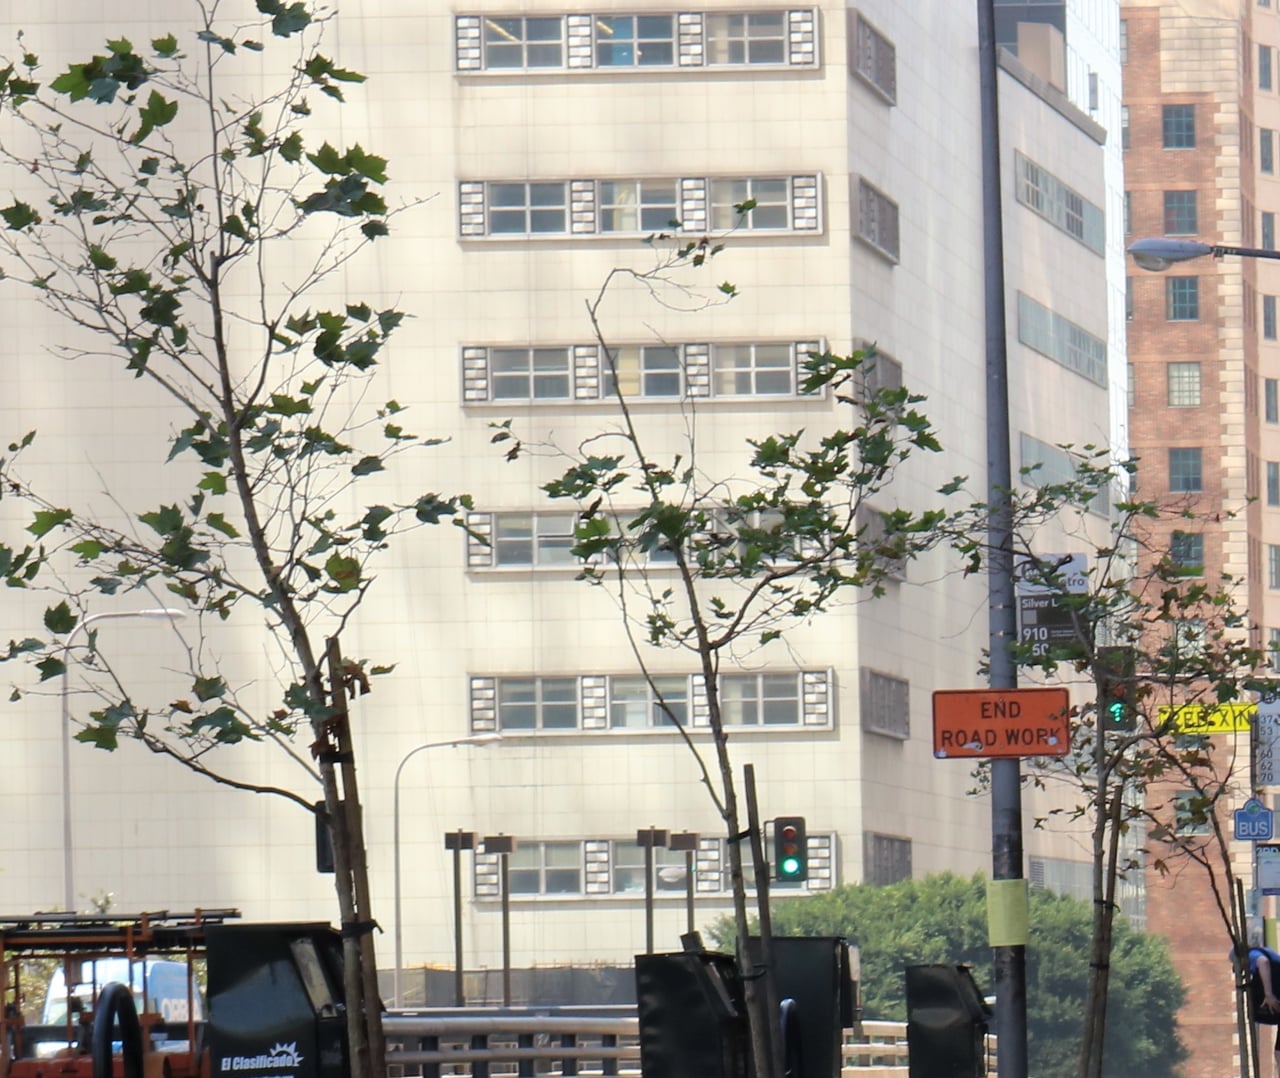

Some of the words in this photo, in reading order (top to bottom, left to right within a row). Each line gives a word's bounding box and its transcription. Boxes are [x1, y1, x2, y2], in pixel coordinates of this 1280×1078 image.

[1022, 598, 1049, 609] Silver
[1023, 627, 1048, 641] 910
[981, 701, 1021, 719] END
[1260, 726, 1273, 736] 53
[941, 729, 997, 748] ROAD
[1005, 727, 1061, 747] WORK
[1260, 750, 1273, 759] 60
[1260, 762, 1273, 771] 62
[1260, 773, 1273, 782] 70
[1239, 821, 1269, 836] BUS
[221, 1057, 232, 1072] El
[232, 1054, 293, 1071] Clasificado
